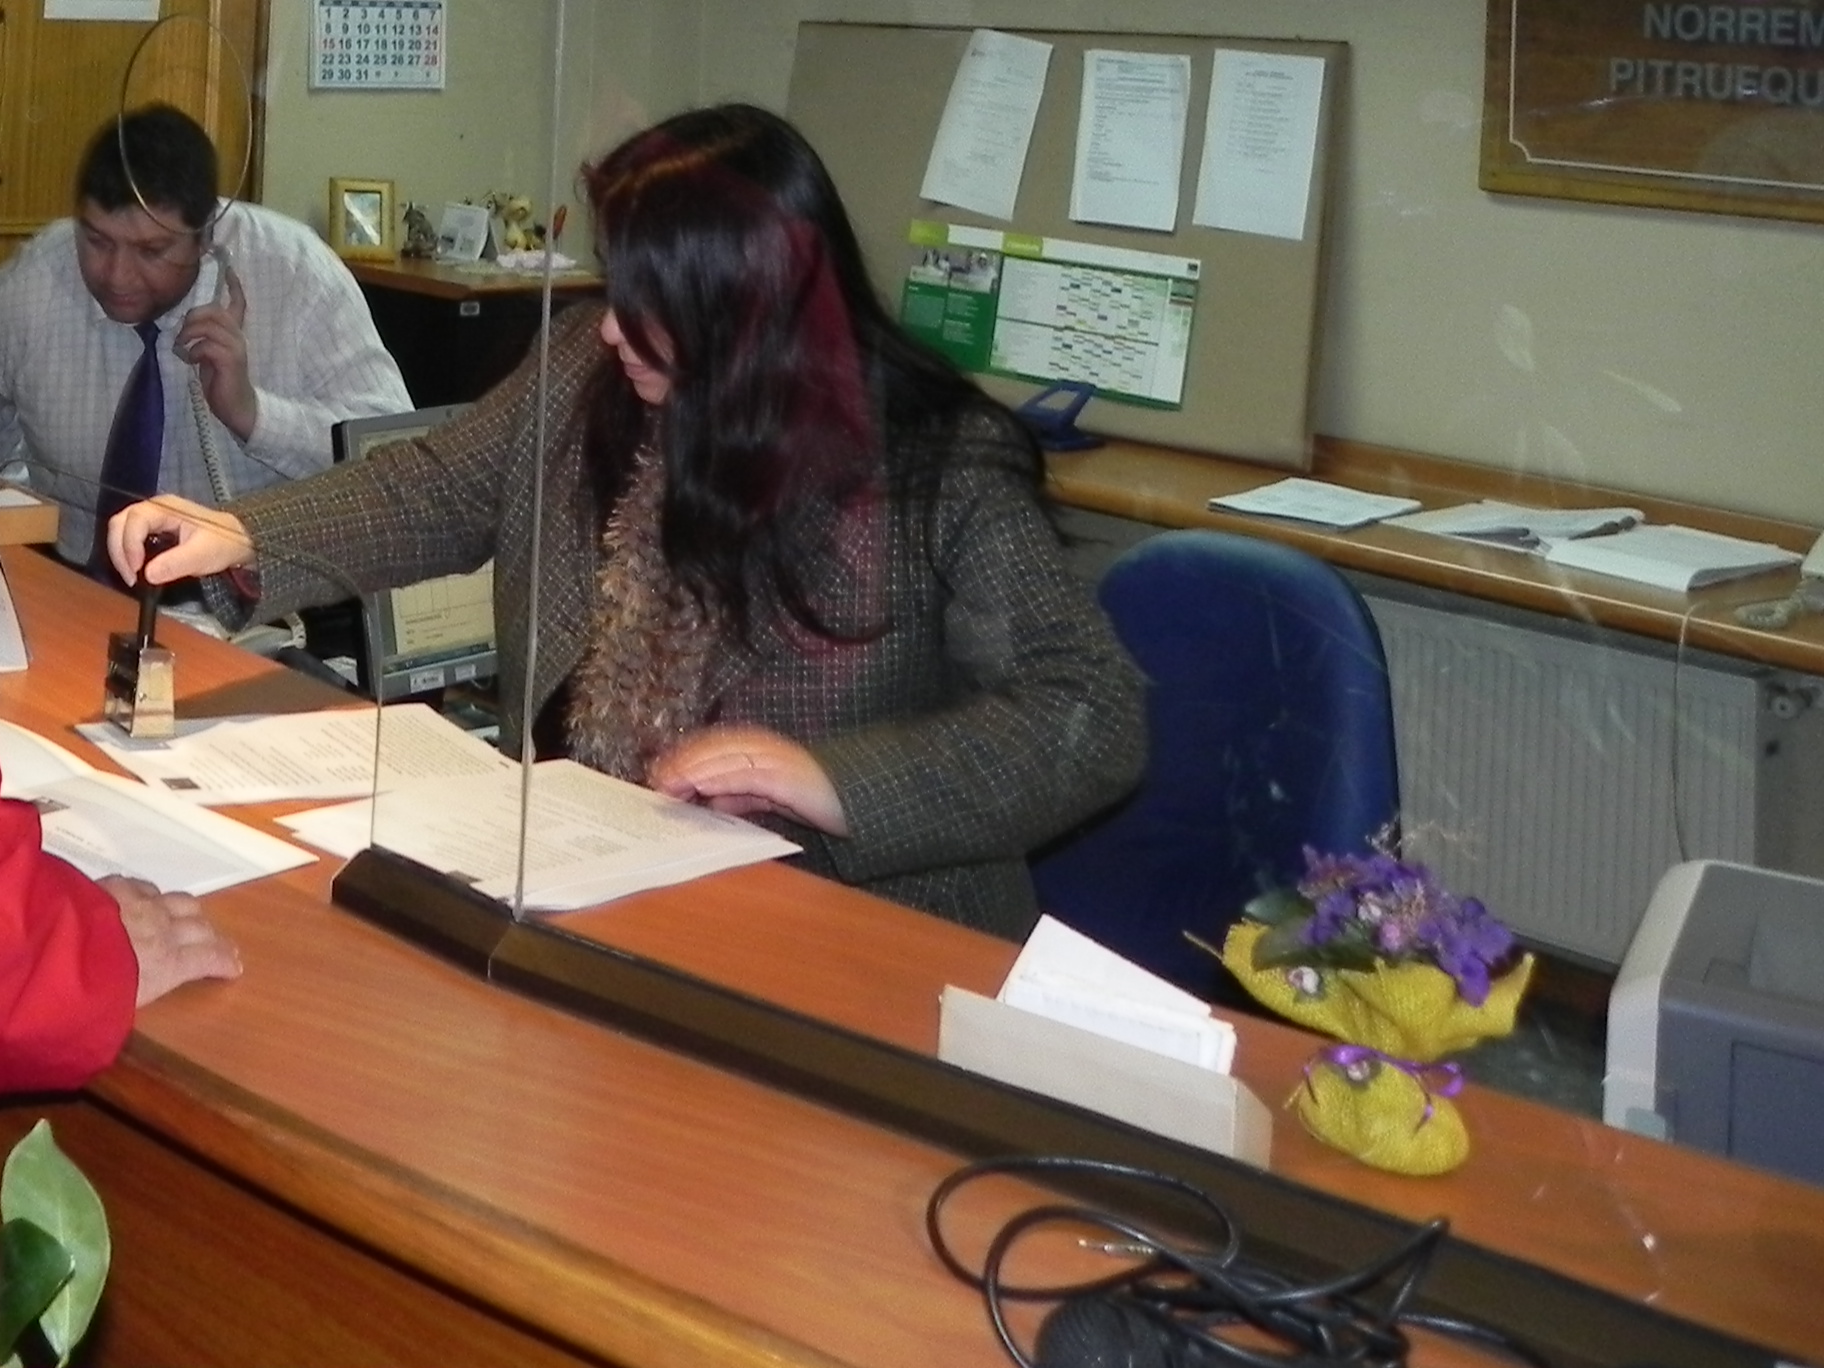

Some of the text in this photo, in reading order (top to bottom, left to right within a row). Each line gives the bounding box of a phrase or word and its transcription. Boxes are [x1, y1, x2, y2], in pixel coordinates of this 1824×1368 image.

[325, 23, 439, 37] 8 9 10 11 12 13 14
[1643, 3, 1824, 47] NORREM
[323, 38, 438, 51] 15 16 17 18 19 20 21
[322, 54, 438, 67] 22 23 24 25 26 27 28
[322, 69, 369, 81] 29 30 31
